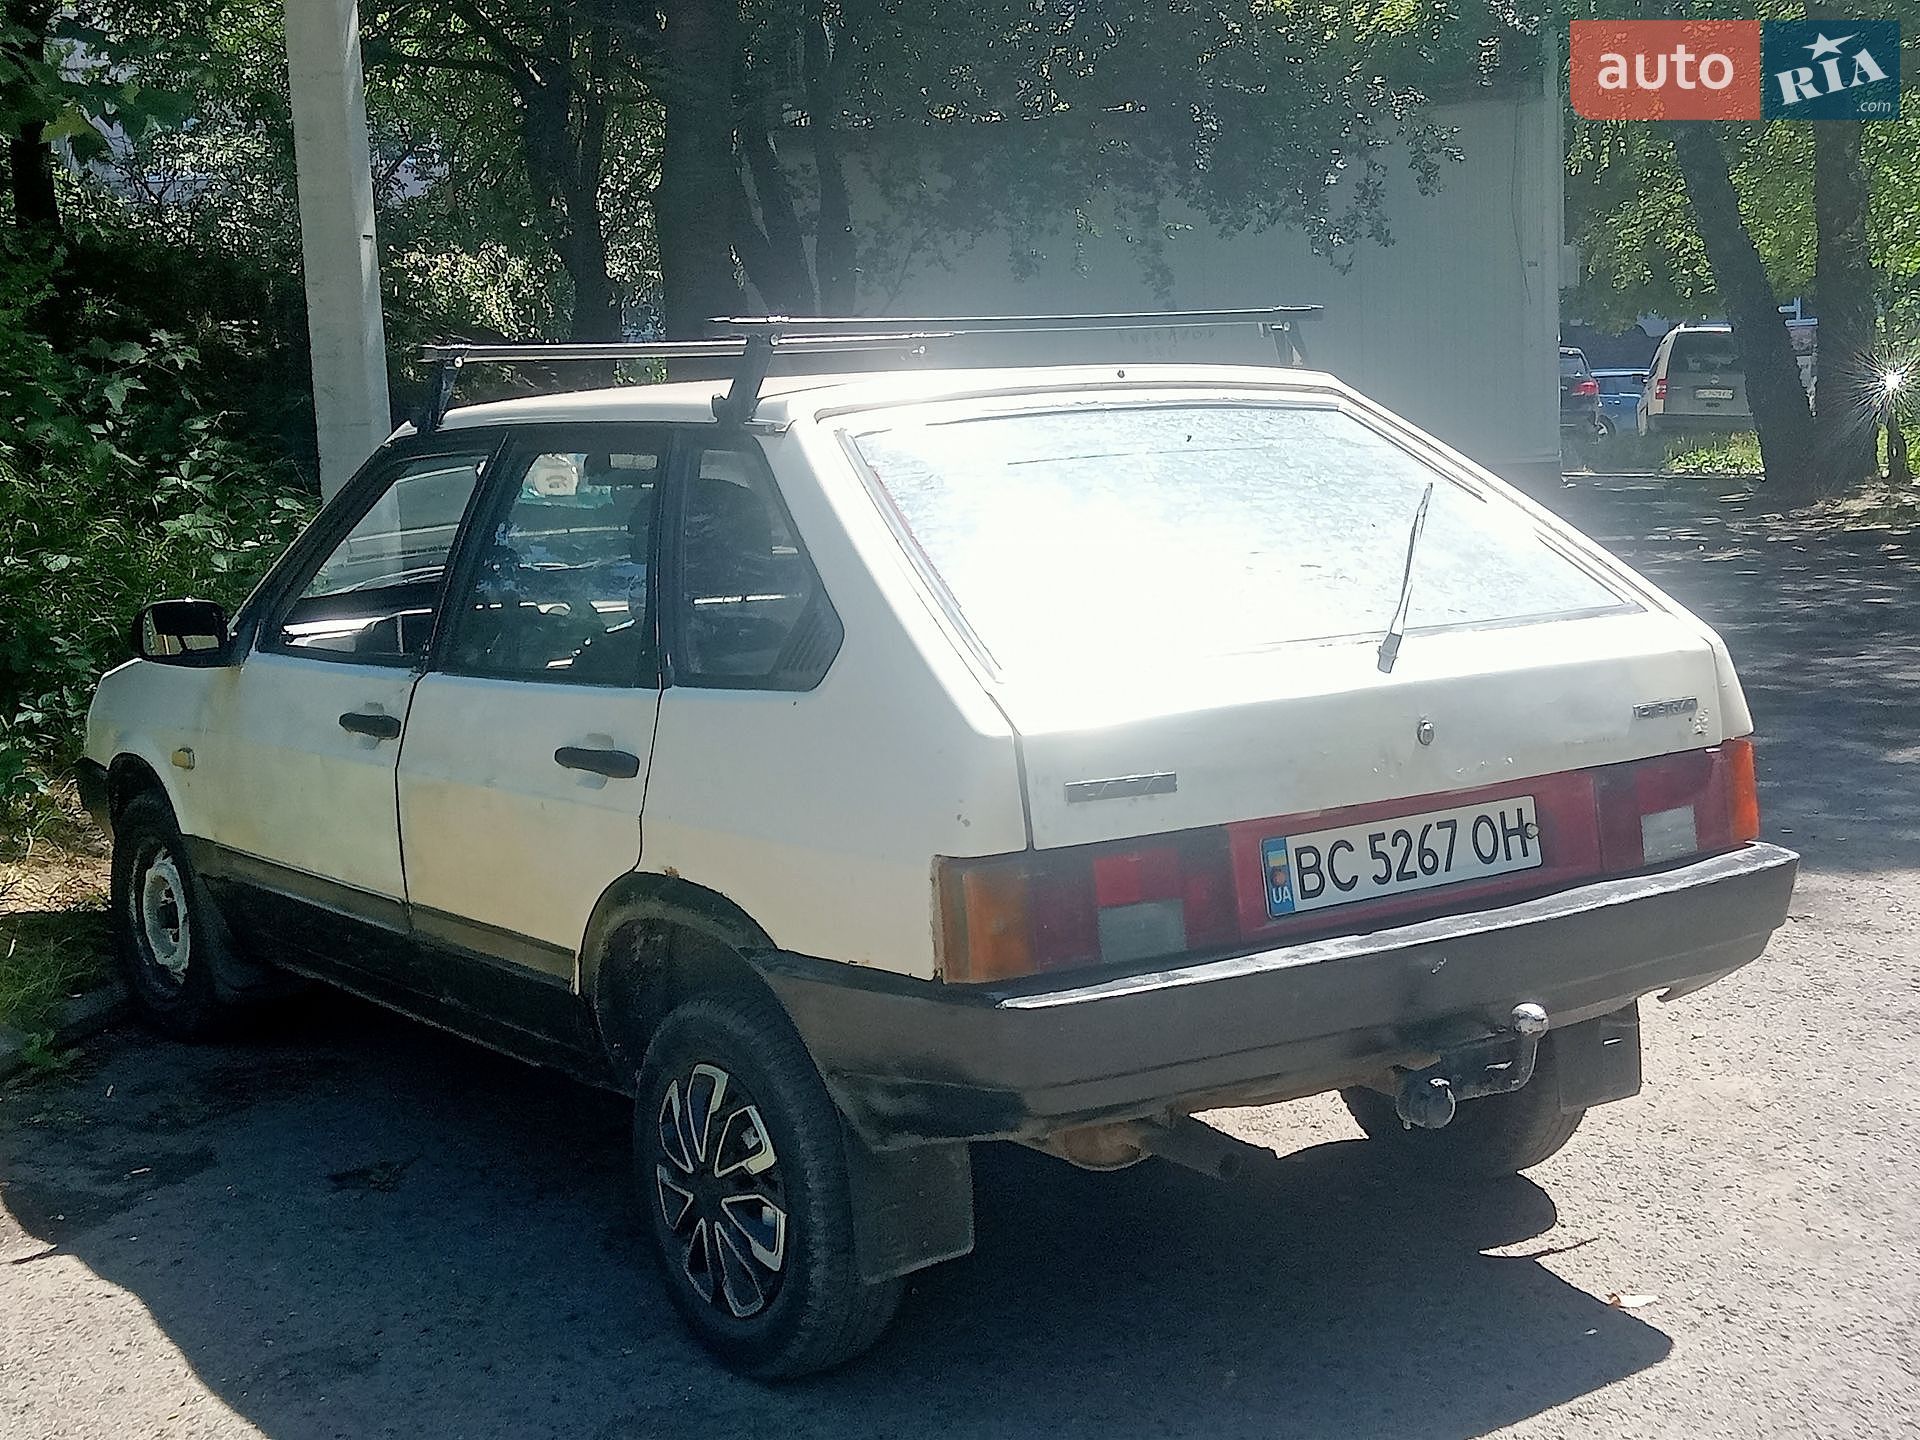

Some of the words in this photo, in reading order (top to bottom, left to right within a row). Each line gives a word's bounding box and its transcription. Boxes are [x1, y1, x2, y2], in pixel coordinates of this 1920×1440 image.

[1295, 839, 1359, 900] BC
[1368, 819, 1457, 885] 5267
[1472, 808, 1529, 865] OH
[1272, 885, 1292, 904] UA
